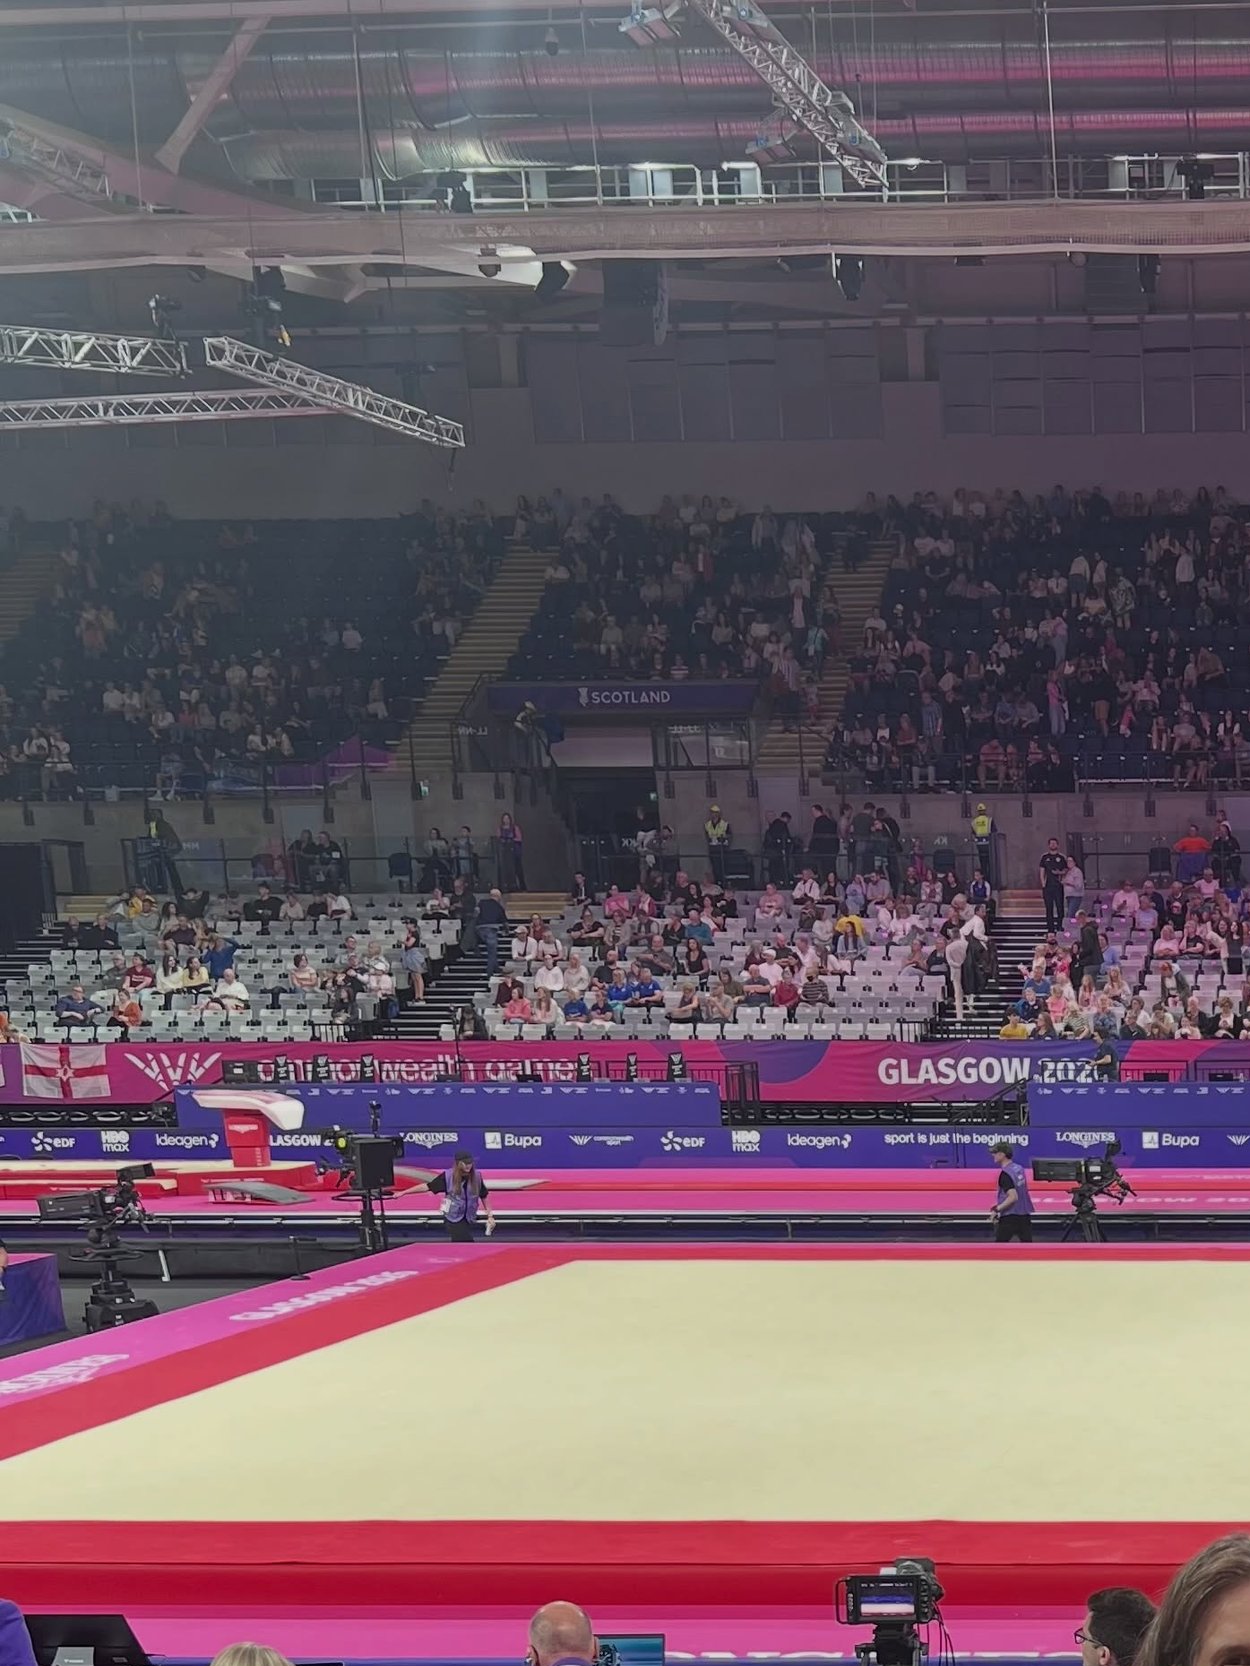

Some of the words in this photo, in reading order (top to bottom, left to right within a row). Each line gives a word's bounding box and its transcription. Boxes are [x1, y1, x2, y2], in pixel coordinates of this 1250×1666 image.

[592, 691, 670, 704] SCOTLAND
[878, 1057, 1031, 1085] GLASGOW
[101, 1131, 130, 1142] HBO
[155, 1133, 208, 1148] Ideagen
[269, 1134, 321, 1146] LASGOW
[504, 1134, 542, 1146] Bupa
[732, 1131, 760, 1142] HBO
[787, 1133, 840, 1148] Ideagen
[884, 1133, 916, 1145] sport
[918, 1132, 928, 1143] is
[928, 1132, 950, 1145] just
[952, 1132, 970, 1144] the
[973, 1132, 1029, 1146] beginning
[1056, 1132, 1115, 1142] LONGINES
[1162, 1134, 1199, 1146] Bupa
[103, 1142, 129, 1152] max
[732, 1142, 760, 1152] max
